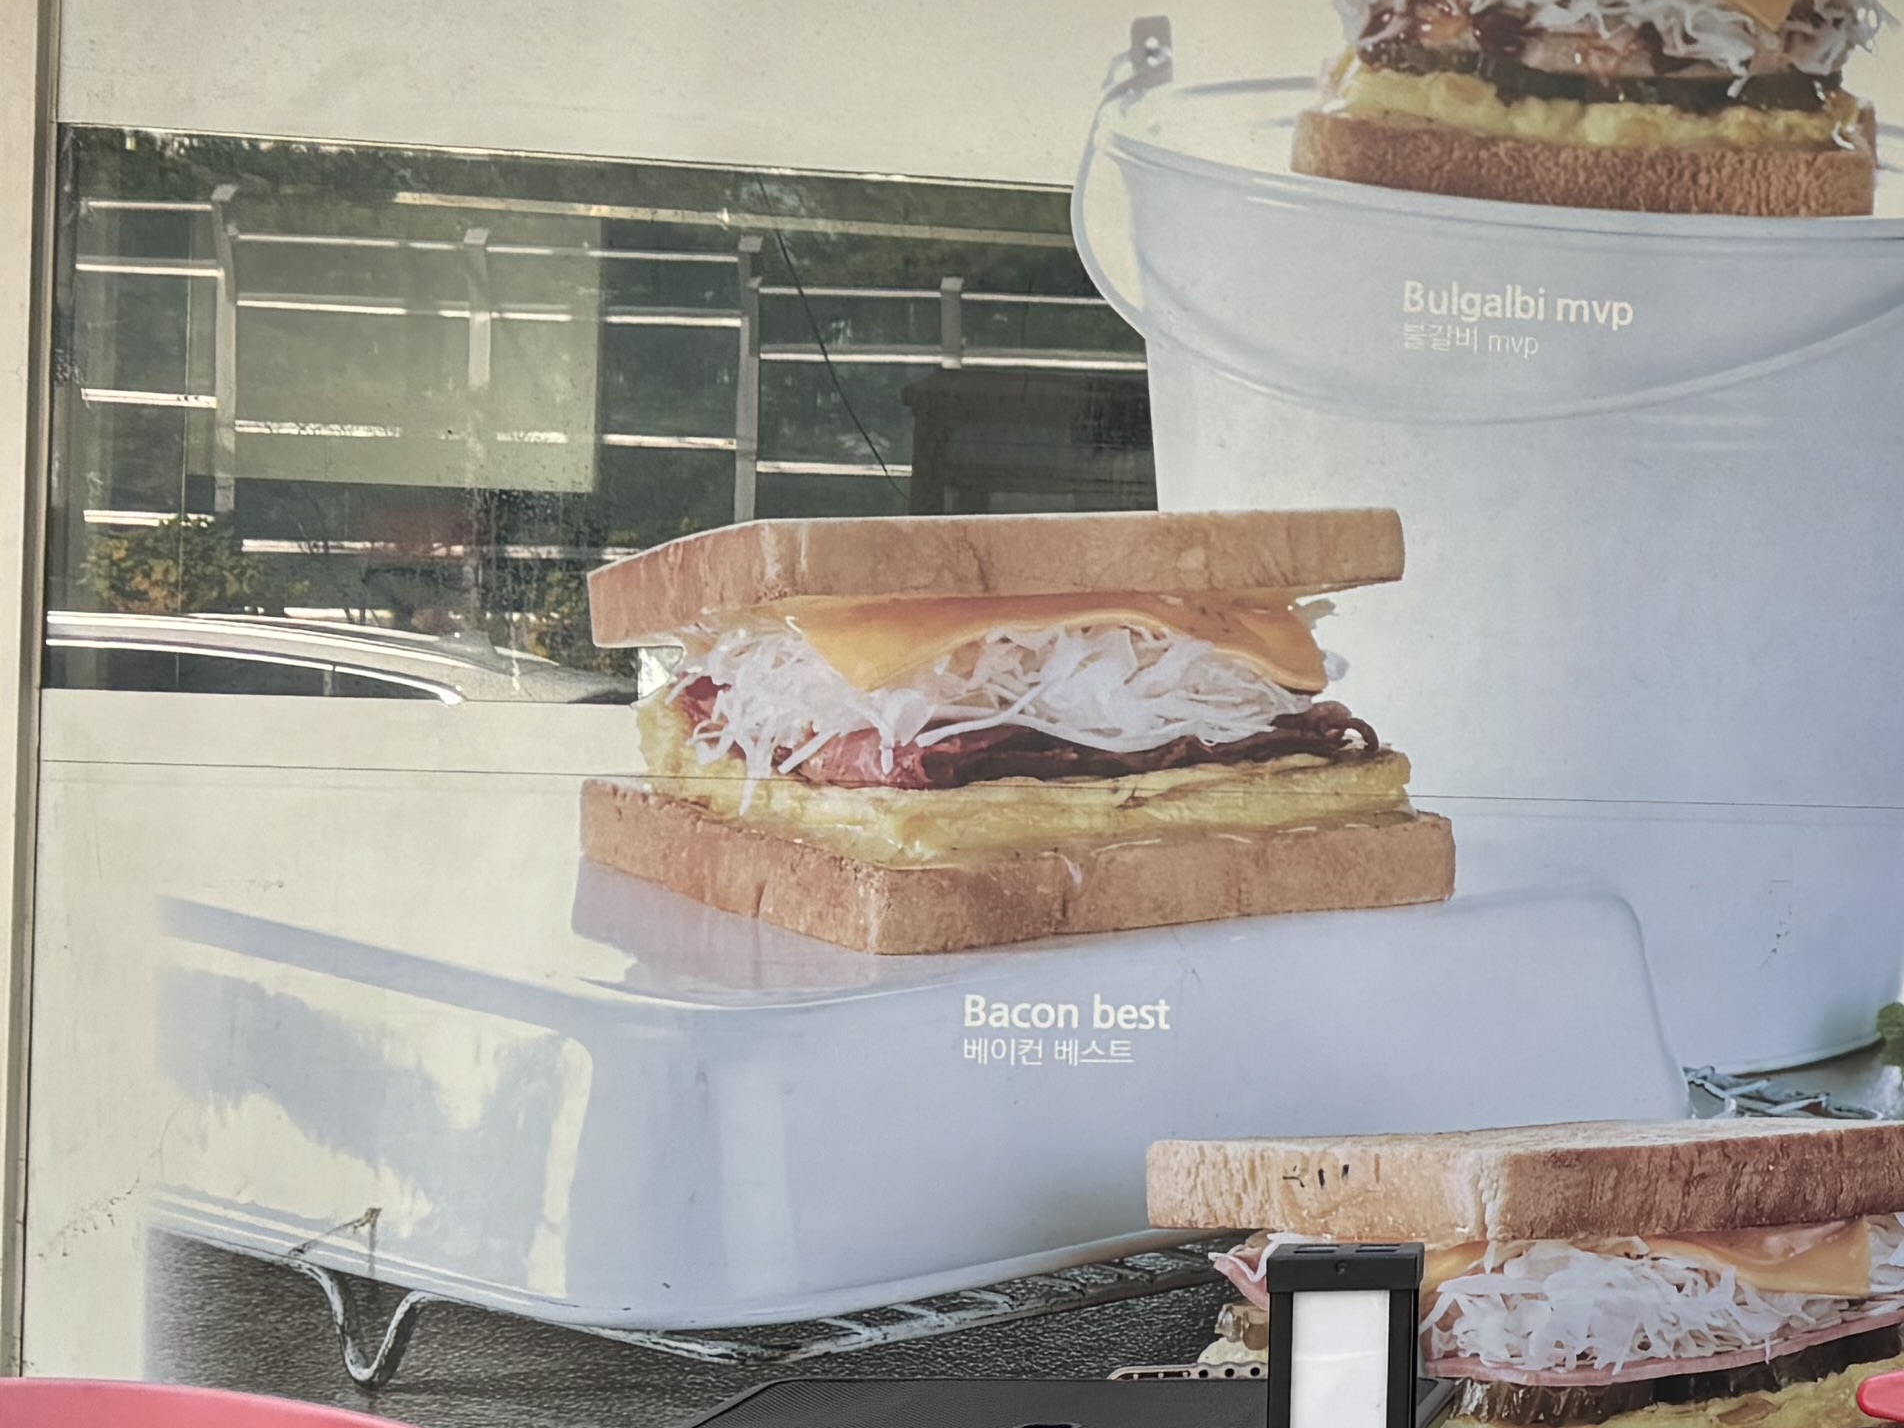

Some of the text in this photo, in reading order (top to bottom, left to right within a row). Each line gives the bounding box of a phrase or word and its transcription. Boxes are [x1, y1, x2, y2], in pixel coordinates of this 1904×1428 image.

[1403, 280, 1633, 330] Bulgalbi mvp
[1403, 324, 1539, 359] 불갈비 mvp
[964, 994, 1171, 1030] Bacon best
[963, 1038, 1134, 1066] 베이컨 베스트
